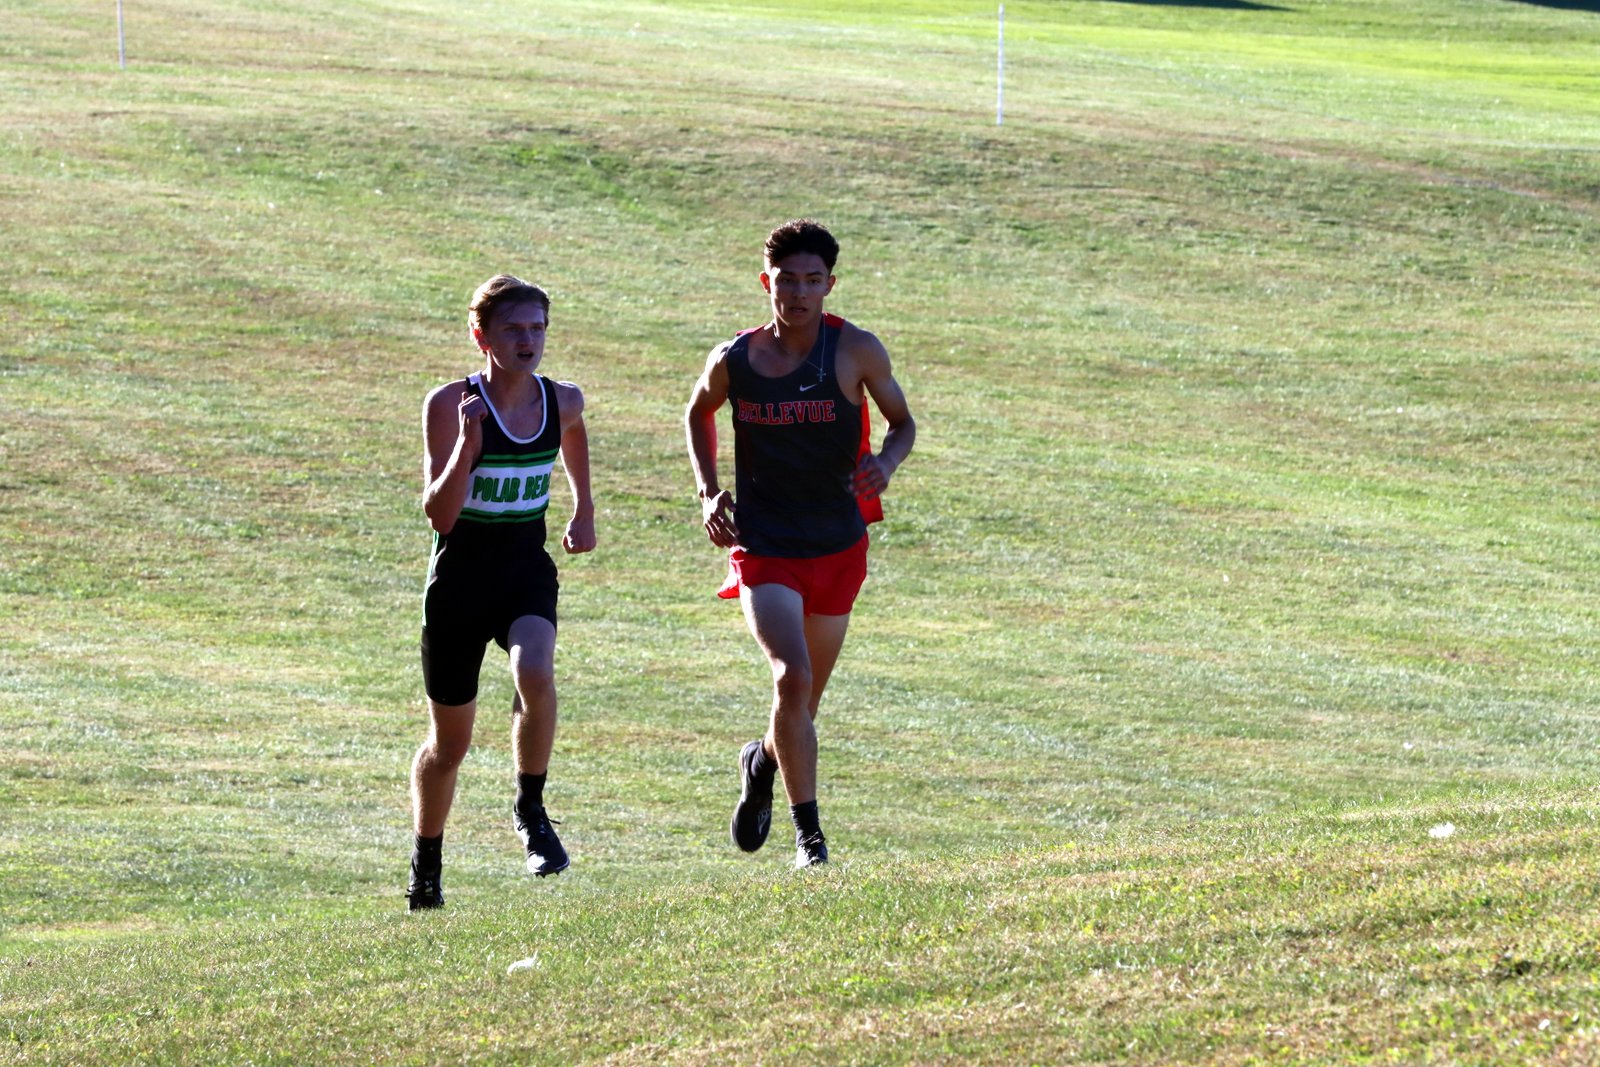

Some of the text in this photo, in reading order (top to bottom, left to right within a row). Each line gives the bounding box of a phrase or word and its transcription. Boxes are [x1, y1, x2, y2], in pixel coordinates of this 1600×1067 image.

[737, 399, 836, 425] BELLEVUE
[472, 472, 551, 503] POLAR BEA
